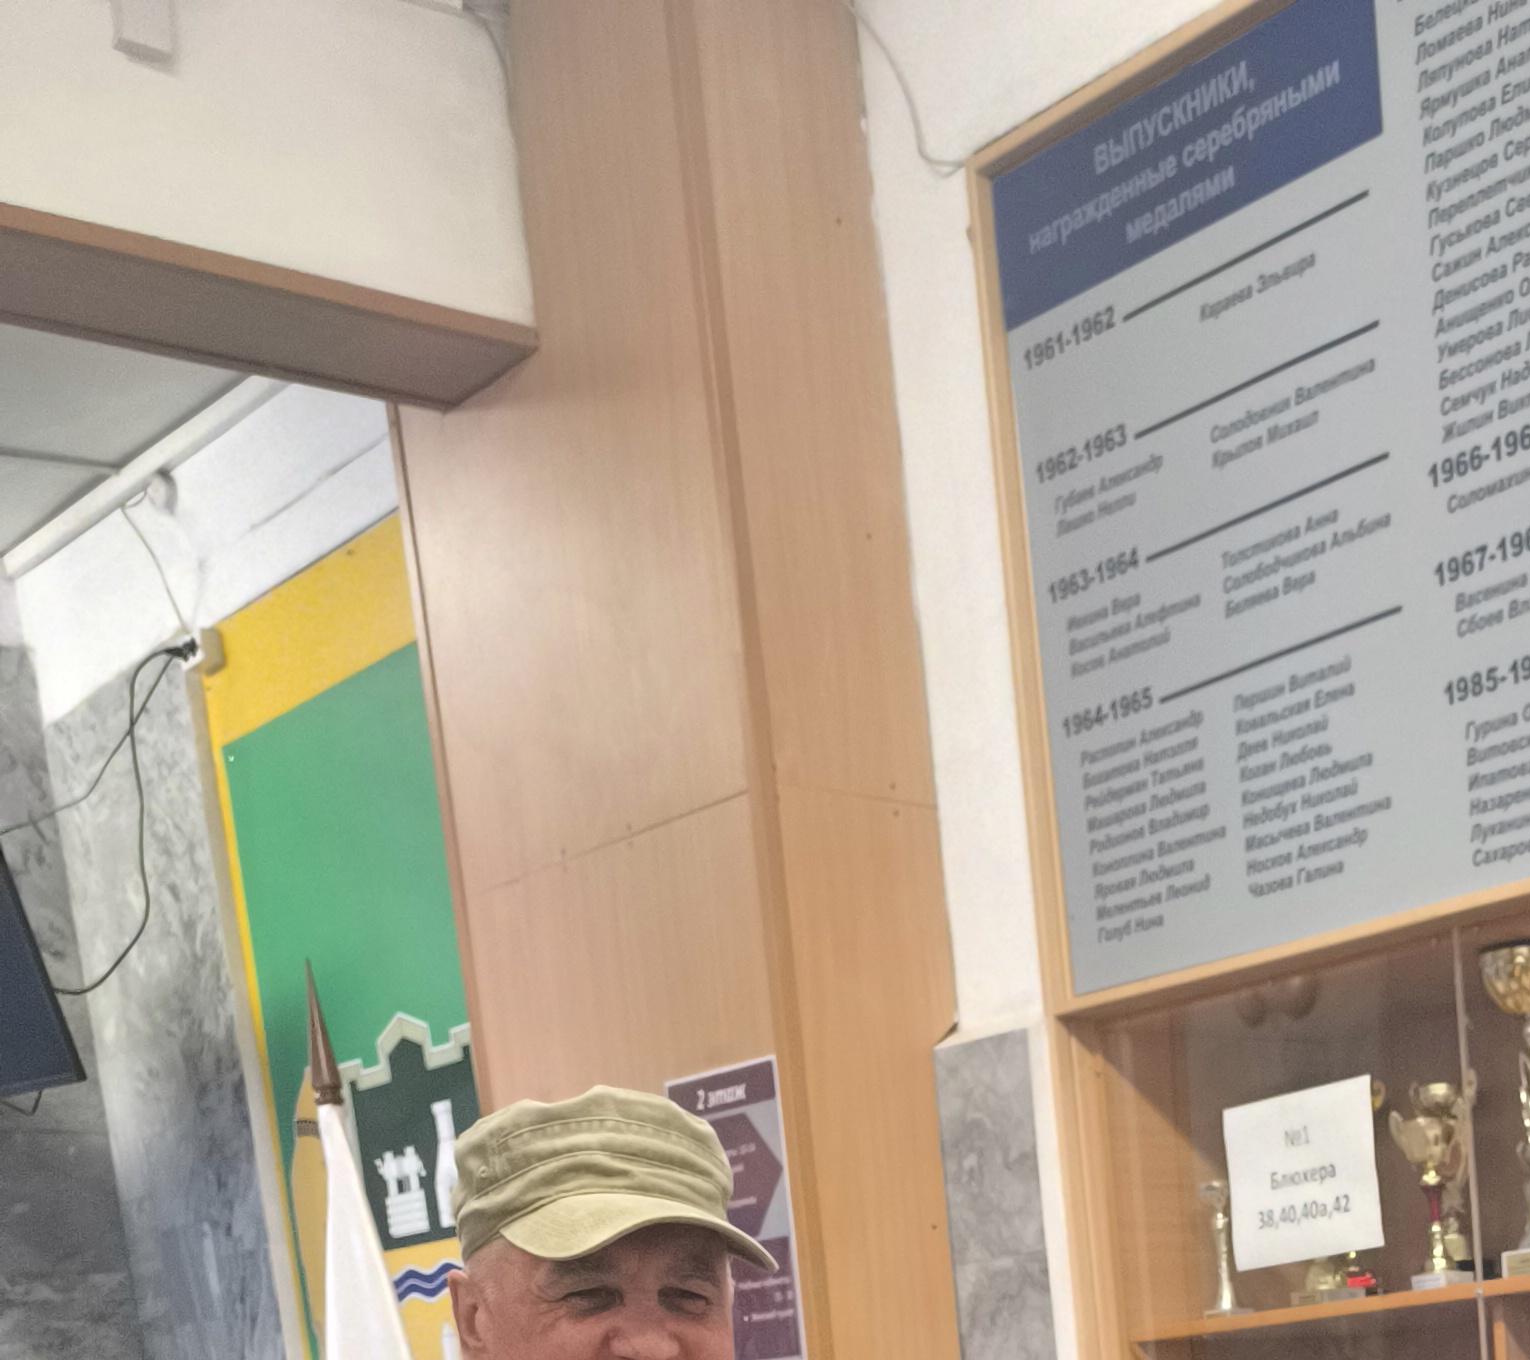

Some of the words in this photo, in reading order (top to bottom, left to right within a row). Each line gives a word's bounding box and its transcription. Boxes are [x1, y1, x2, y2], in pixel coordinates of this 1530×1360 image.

[1415, 17, 1482, 65] Ломаева
[1417, 40, 1492, 93] Ляпунова
[1419, 70, 1490, 120] Ярмушка
[1093, 60, 1255, 175] ВЫПУСКНИКИ,
[1029, 155, 1177, 254] награжденные
[1182, 60, 1340, 168] серебряными
[1424, 132, 1484, 174] Паршко
[1426, 154, 1498, 202] Кузнецов
[1126, 166, 1235, 244] медалями
[1430, 210, 1500, 257] Гуськова
[1432, 264, 1507, 316] Денисова
[1024, 306, 1115, 370] 1961-1962
[1438, 322, 1503, 363] Умерова
[1294, 359, 1375, 406] Валентина
[1438, 342, 1521, 391] Бессонова
[1440, 381, 1496, 417] Семчук
[1036, 424, 1126, 484] 1962-1963
[1304, 510, 1338, 534] Анна
[1048, 548, 1139, 603] 1963-1964
[1282, 572, 1315, 595] Вера
[1457, 610, 1503, 638] Сбоев
[1062, 687, 1152, 738] 1964-1965
[1314, 684, 1354, 709] Елена
[1272, 716, 1328, 747] Николай
[1309, 753, 1372, 785] Людмила
[1301, 780, 1357, 810] Николай
[1314, 797, 1391, 832] Валентина
[1296, 828, 1367, 860] Александр
[696, 1088, 705, 1110] 2
[1284, 1125, 1310, 1147] №1
[1270, 1163, 1337, 1190] Блюхера
